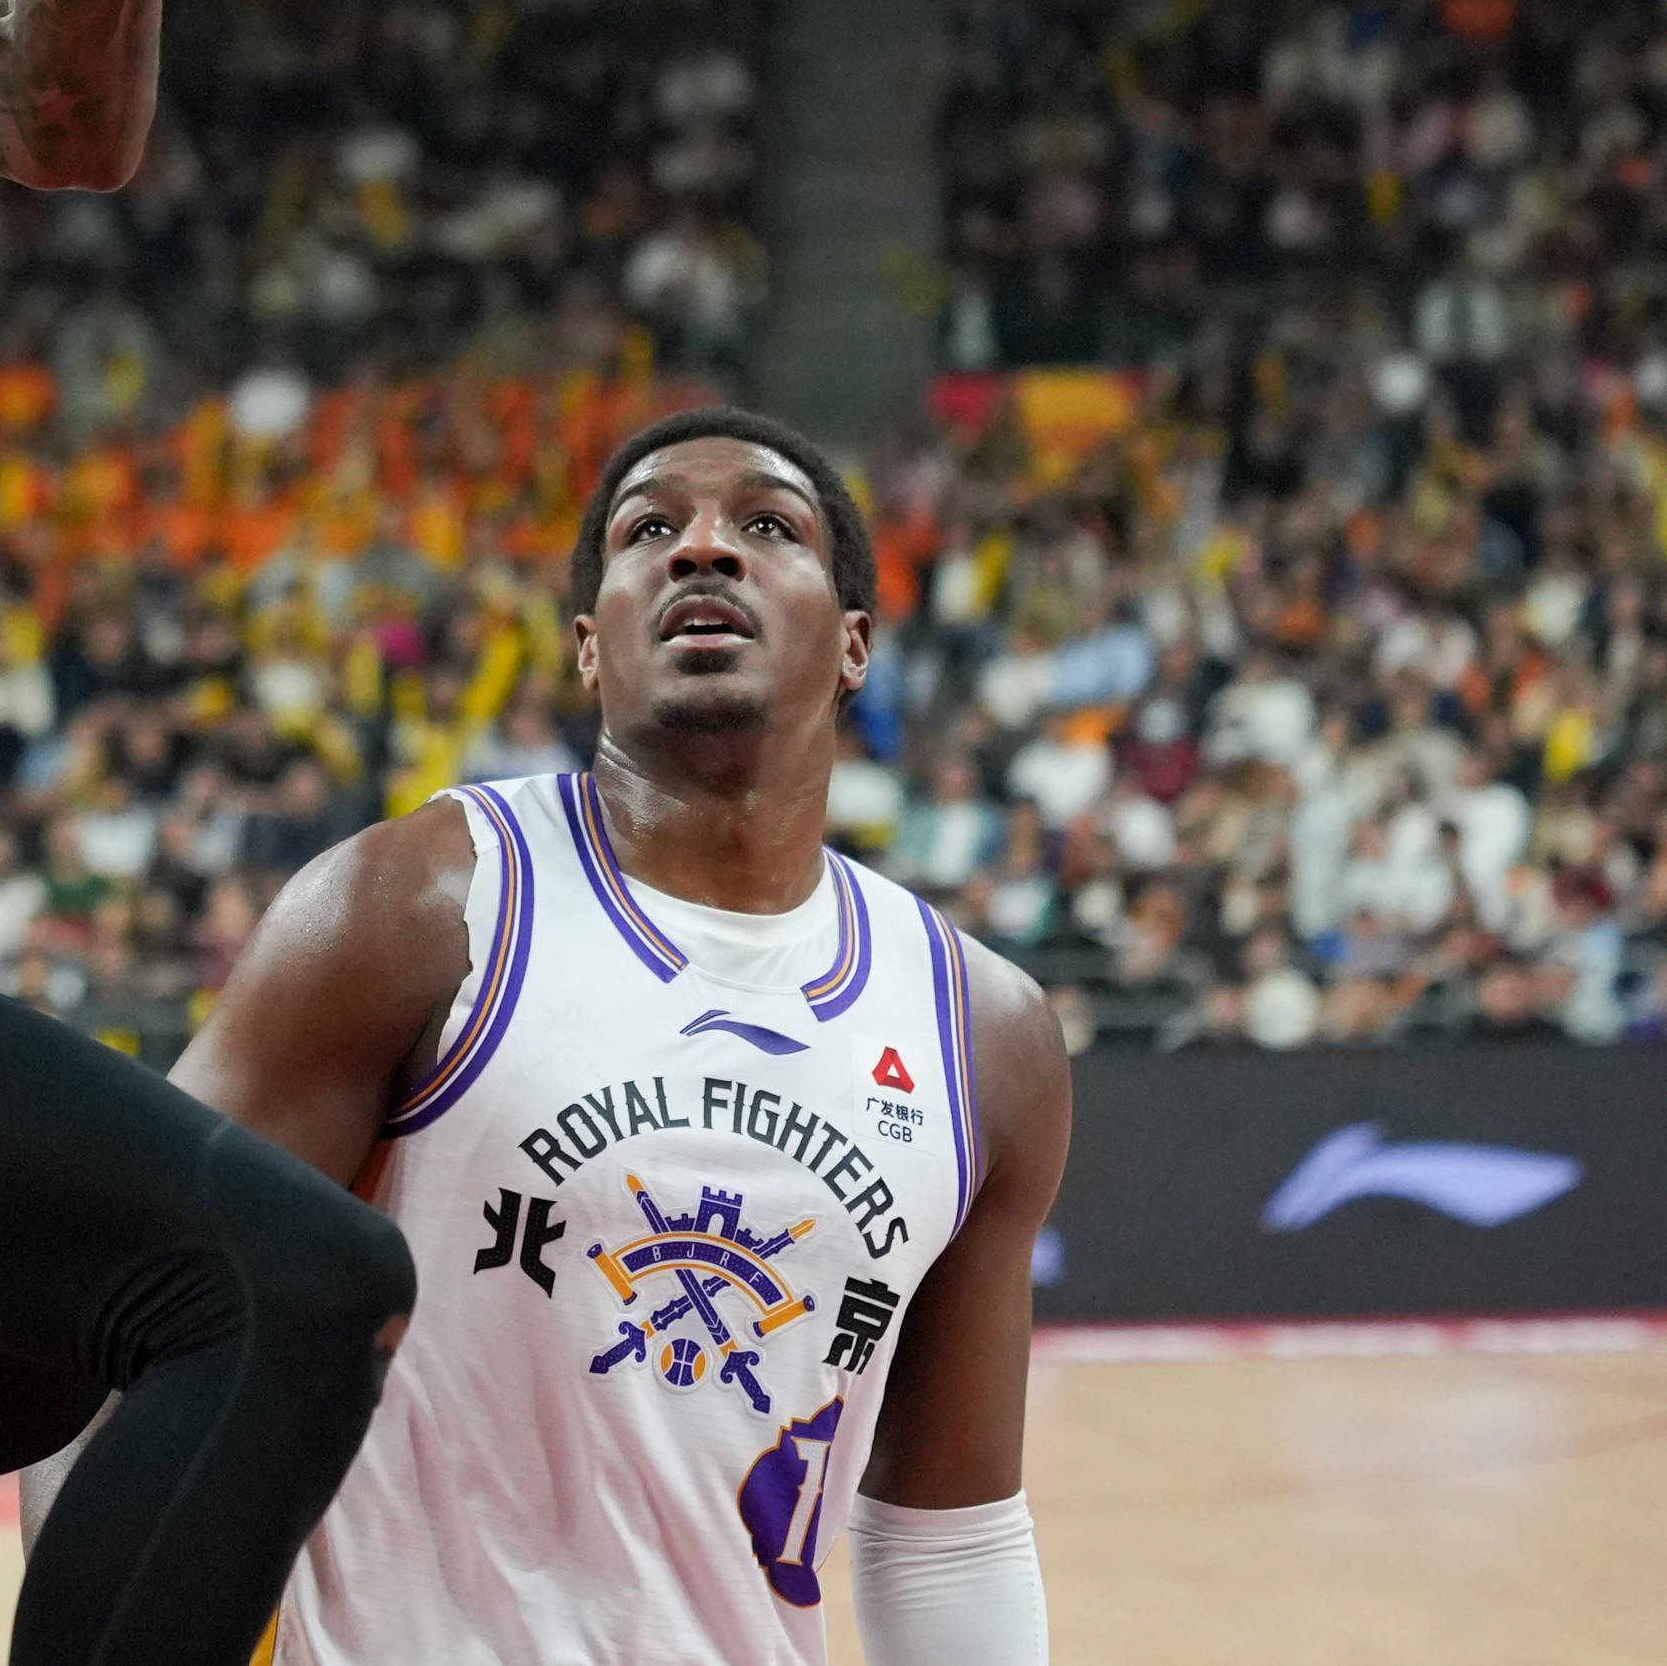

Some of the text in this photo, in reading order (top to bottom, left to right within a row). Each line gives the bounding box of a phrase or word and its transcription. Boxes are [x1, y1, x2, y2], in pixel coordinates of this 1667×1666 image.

[865, 1096, 924, 1127] 广发银行
[877, 1119, 913, 1144] CGB
[517, 1075, 910, 1260] ROYAL FIGHTERS
[473, 1186, 901, 1376] 北 京
[651, 1243, 764, 1285] BJRF
